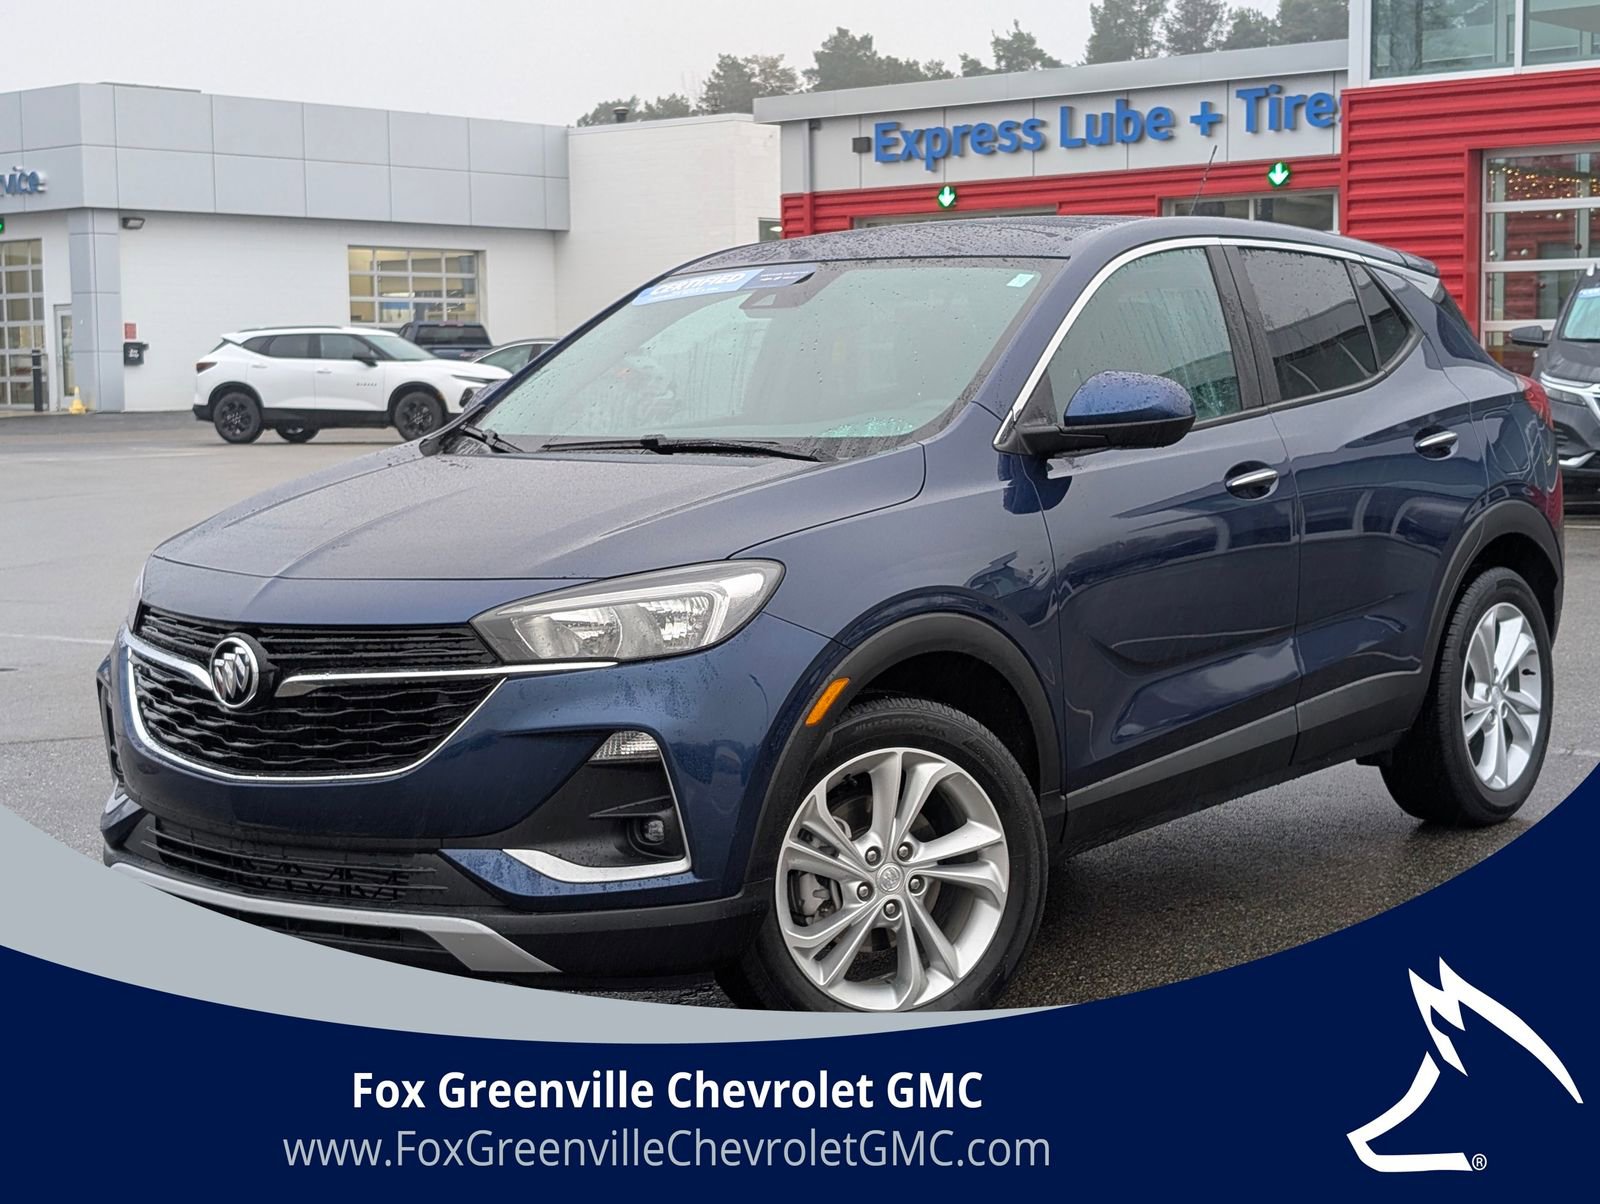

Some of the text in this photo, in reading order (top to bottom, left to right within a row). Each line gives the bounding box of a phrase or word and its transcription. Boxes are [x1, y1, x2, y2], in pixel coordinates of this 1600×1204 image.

[874, 84, 1342, 171] Express Lube + Tire
[0, 166, 46, 195] vice
